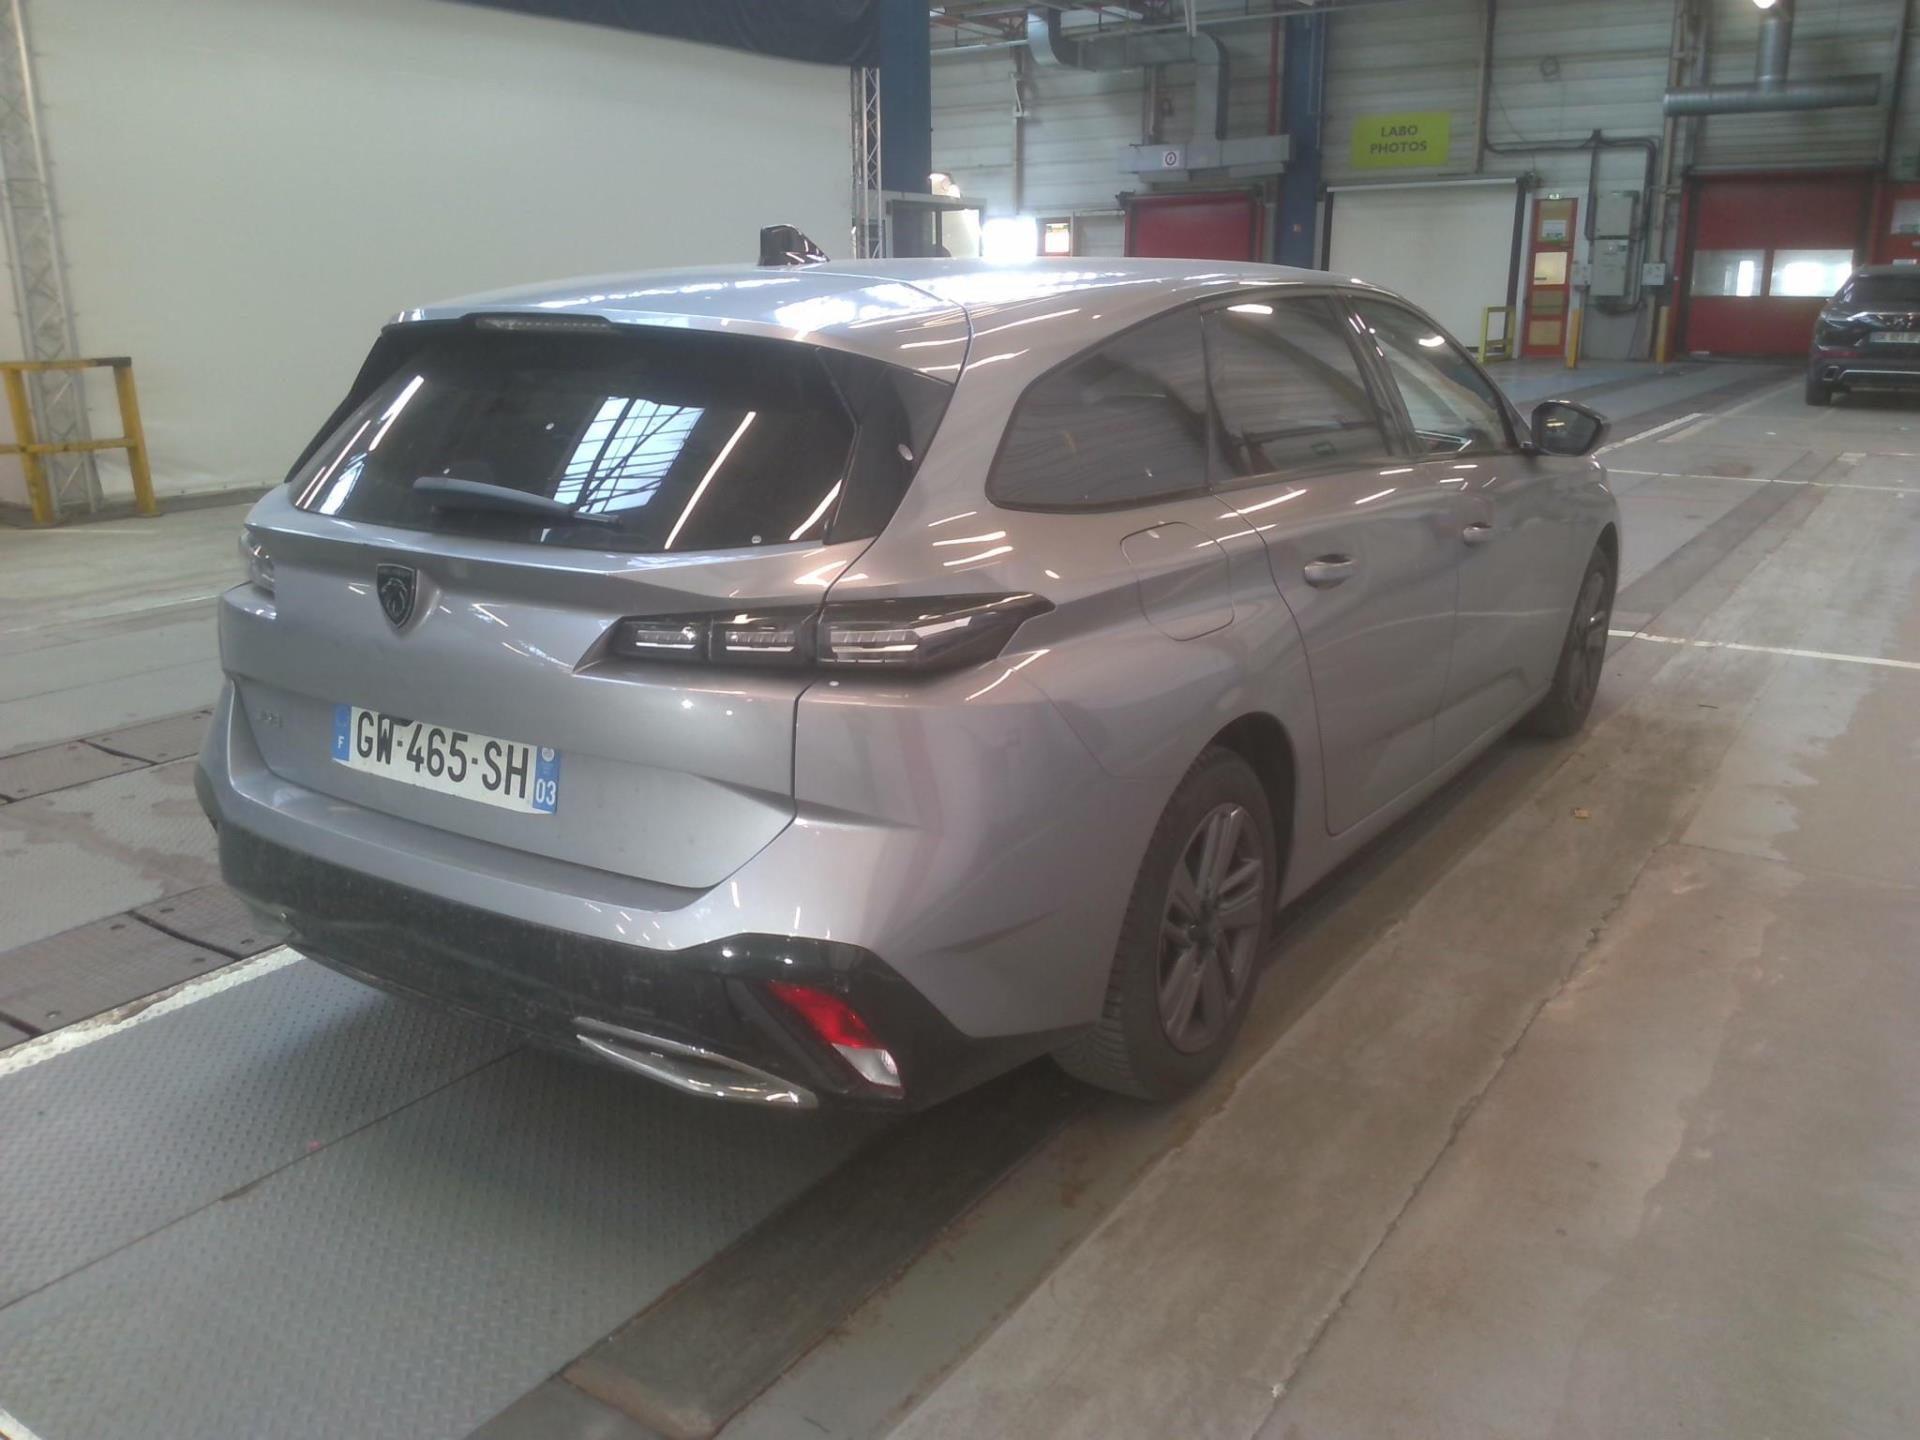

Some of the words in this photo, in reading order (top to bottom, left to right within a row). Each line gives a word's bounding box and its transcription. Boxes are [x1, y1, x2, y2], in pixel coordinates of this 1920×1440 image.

[1381, 125, 1418, 137] LABO
[1370, 140, 1427, 154] PHOTOS
[337, 736, 345, 749] F
[357, 711, 529, 799] GW-465-SH
[535, 778, 557, 806] 03
